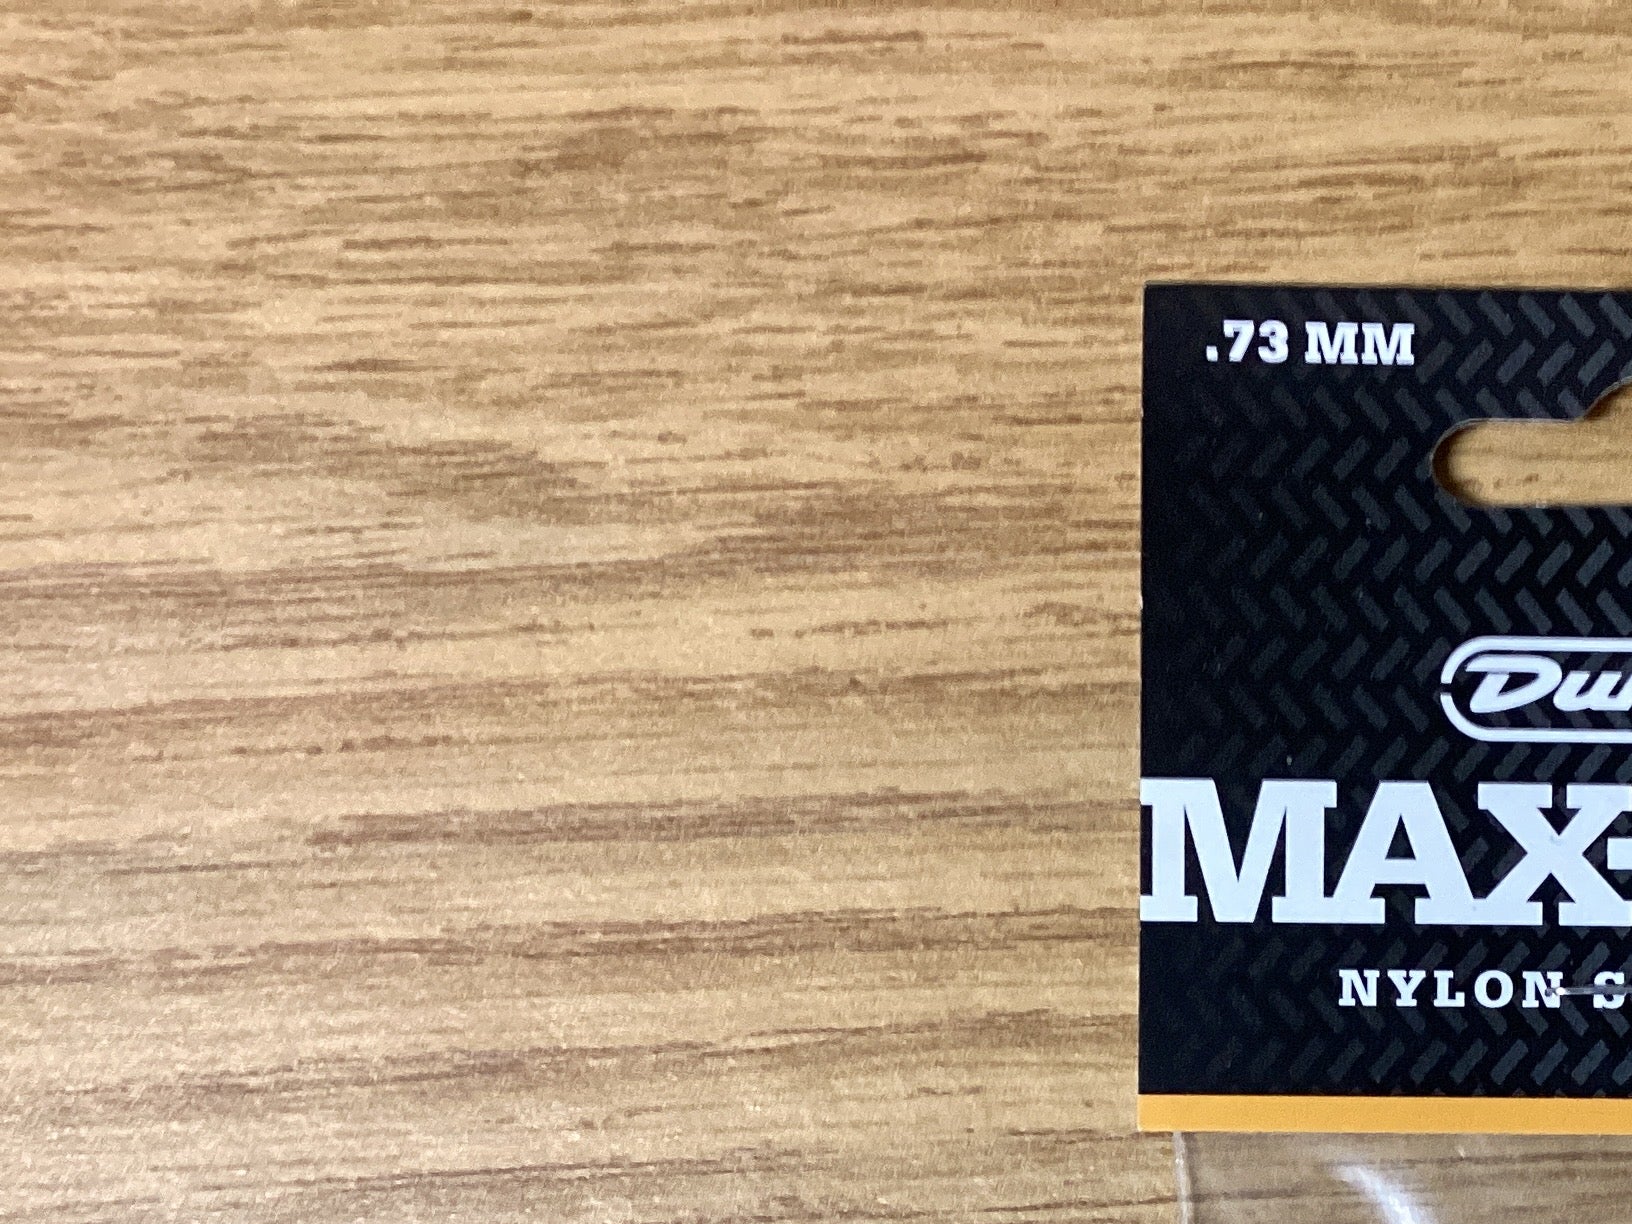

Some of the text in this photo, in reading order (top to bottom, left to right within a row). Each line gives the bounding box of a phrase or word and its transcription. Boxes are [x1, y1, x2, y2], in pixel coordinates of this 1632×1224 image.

[1205, 319, 1415, 366] .73 MM
[1338, 968, 1564, 1007] NYLON
